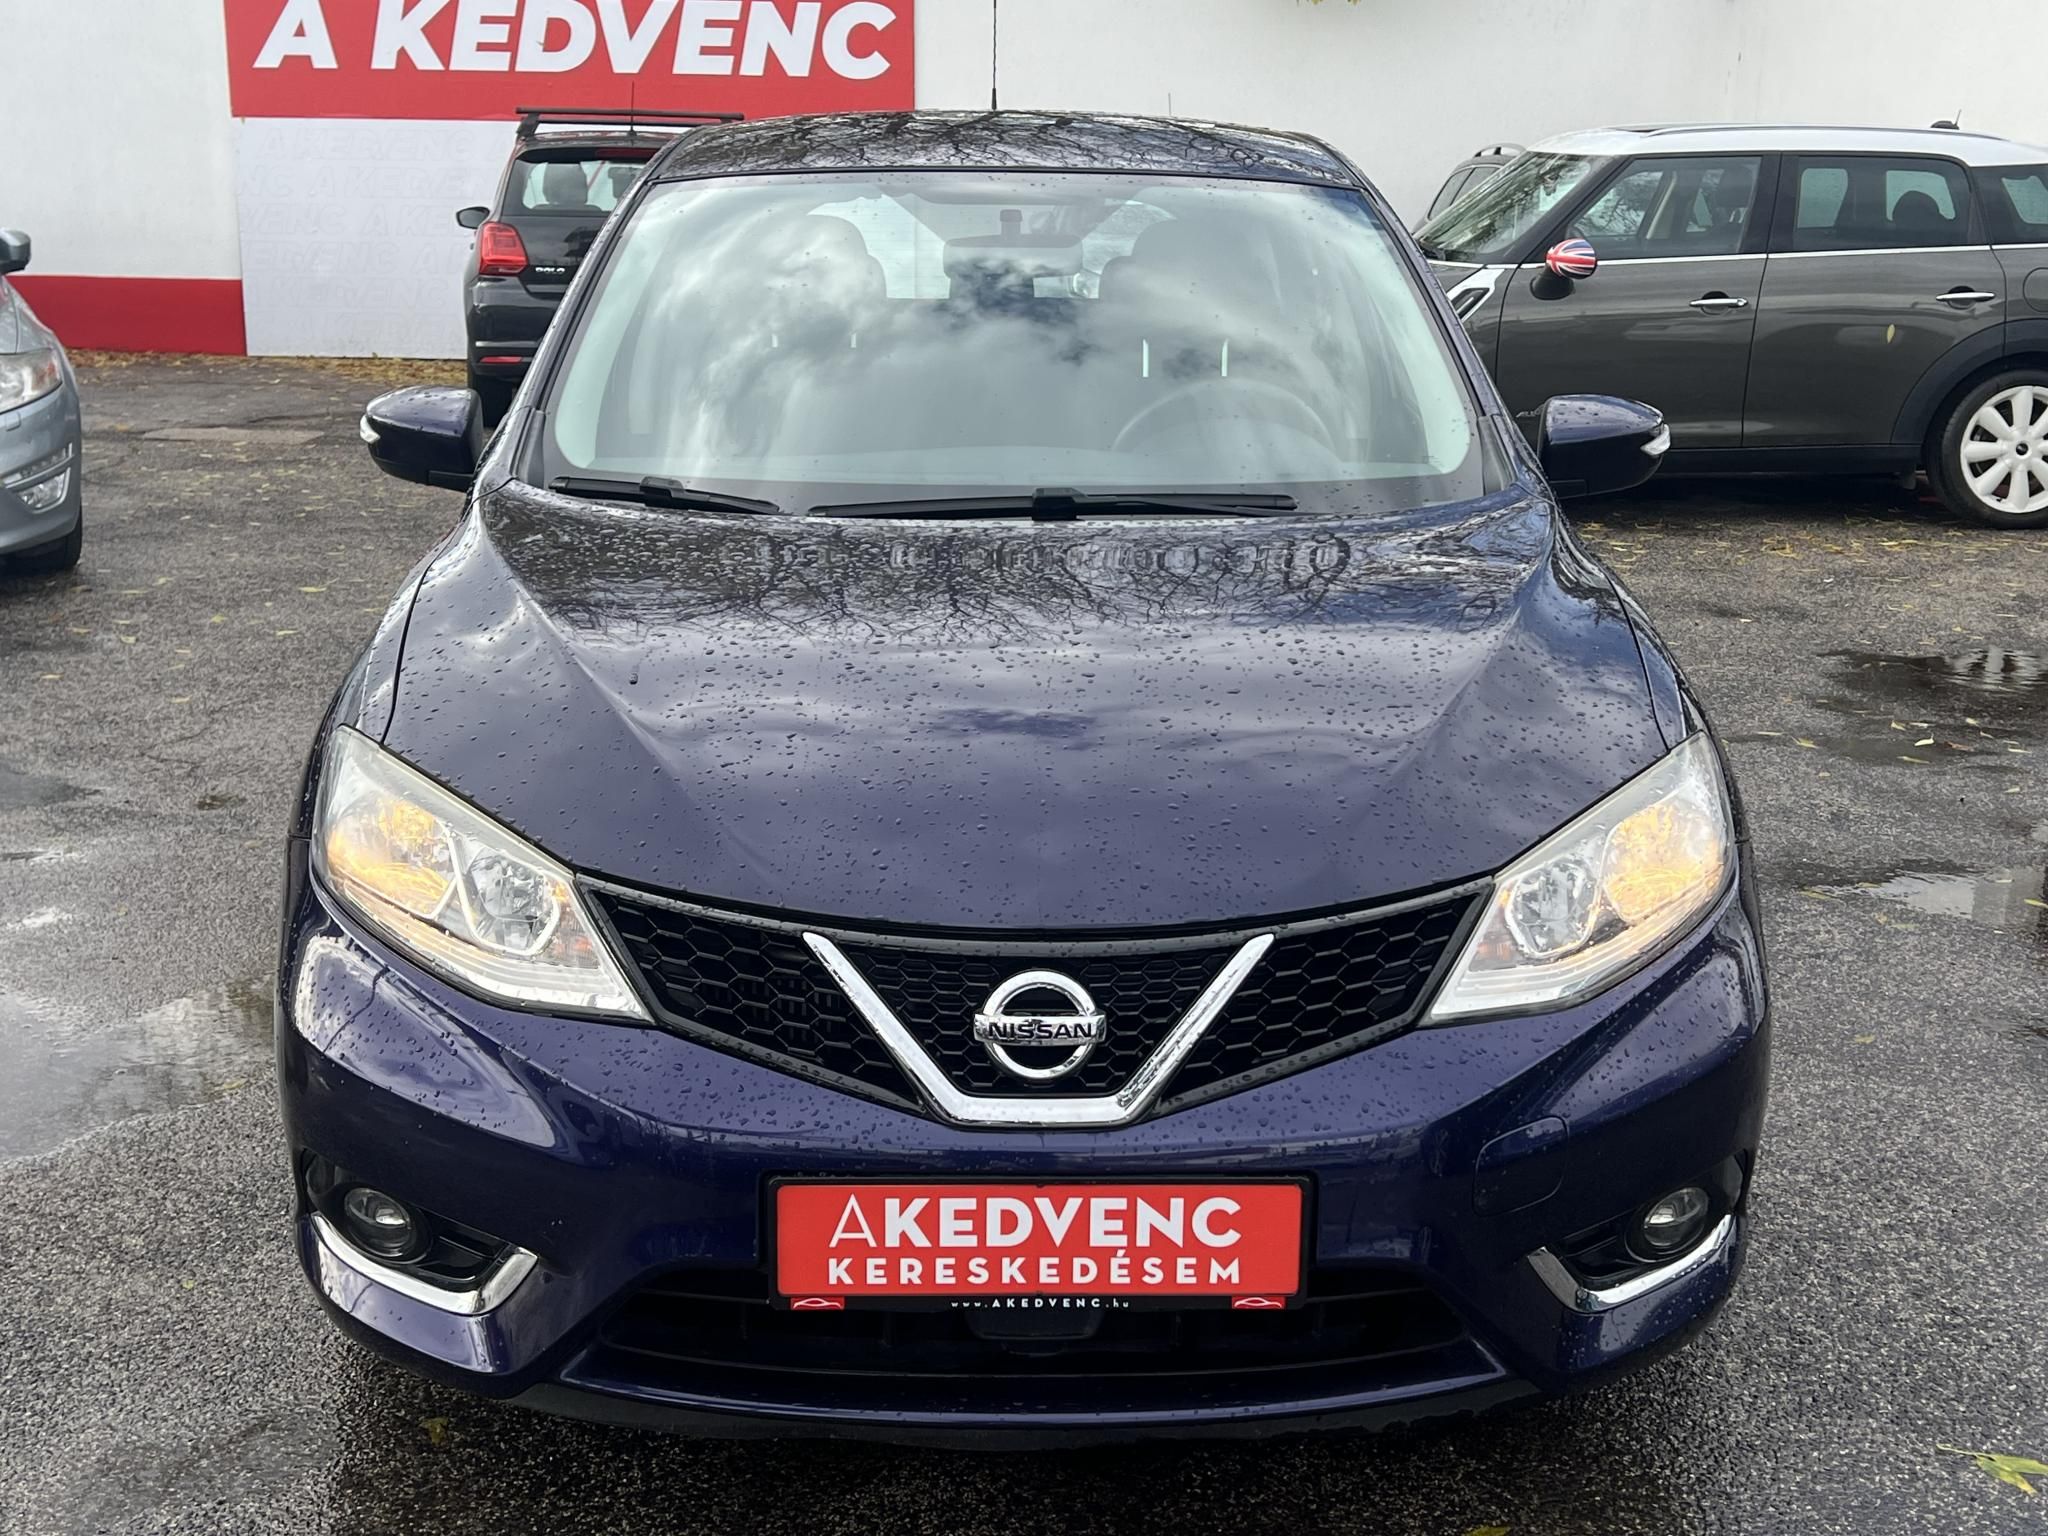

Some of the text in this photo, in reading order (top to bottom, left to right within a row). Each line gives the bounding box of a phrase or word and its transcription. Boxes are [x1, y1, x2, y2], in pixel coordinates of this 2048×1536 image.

[253, 0, 897, 80] A KEDVENC
[535, 266, 566, 275] POLO
[988, 1022, 1092, 1040] NISSAN
[828, 1248, 1241, 1285] KERESKEDÉSEM
[951, 1297, 1130, 1308] www.AKEDVENC.hu
